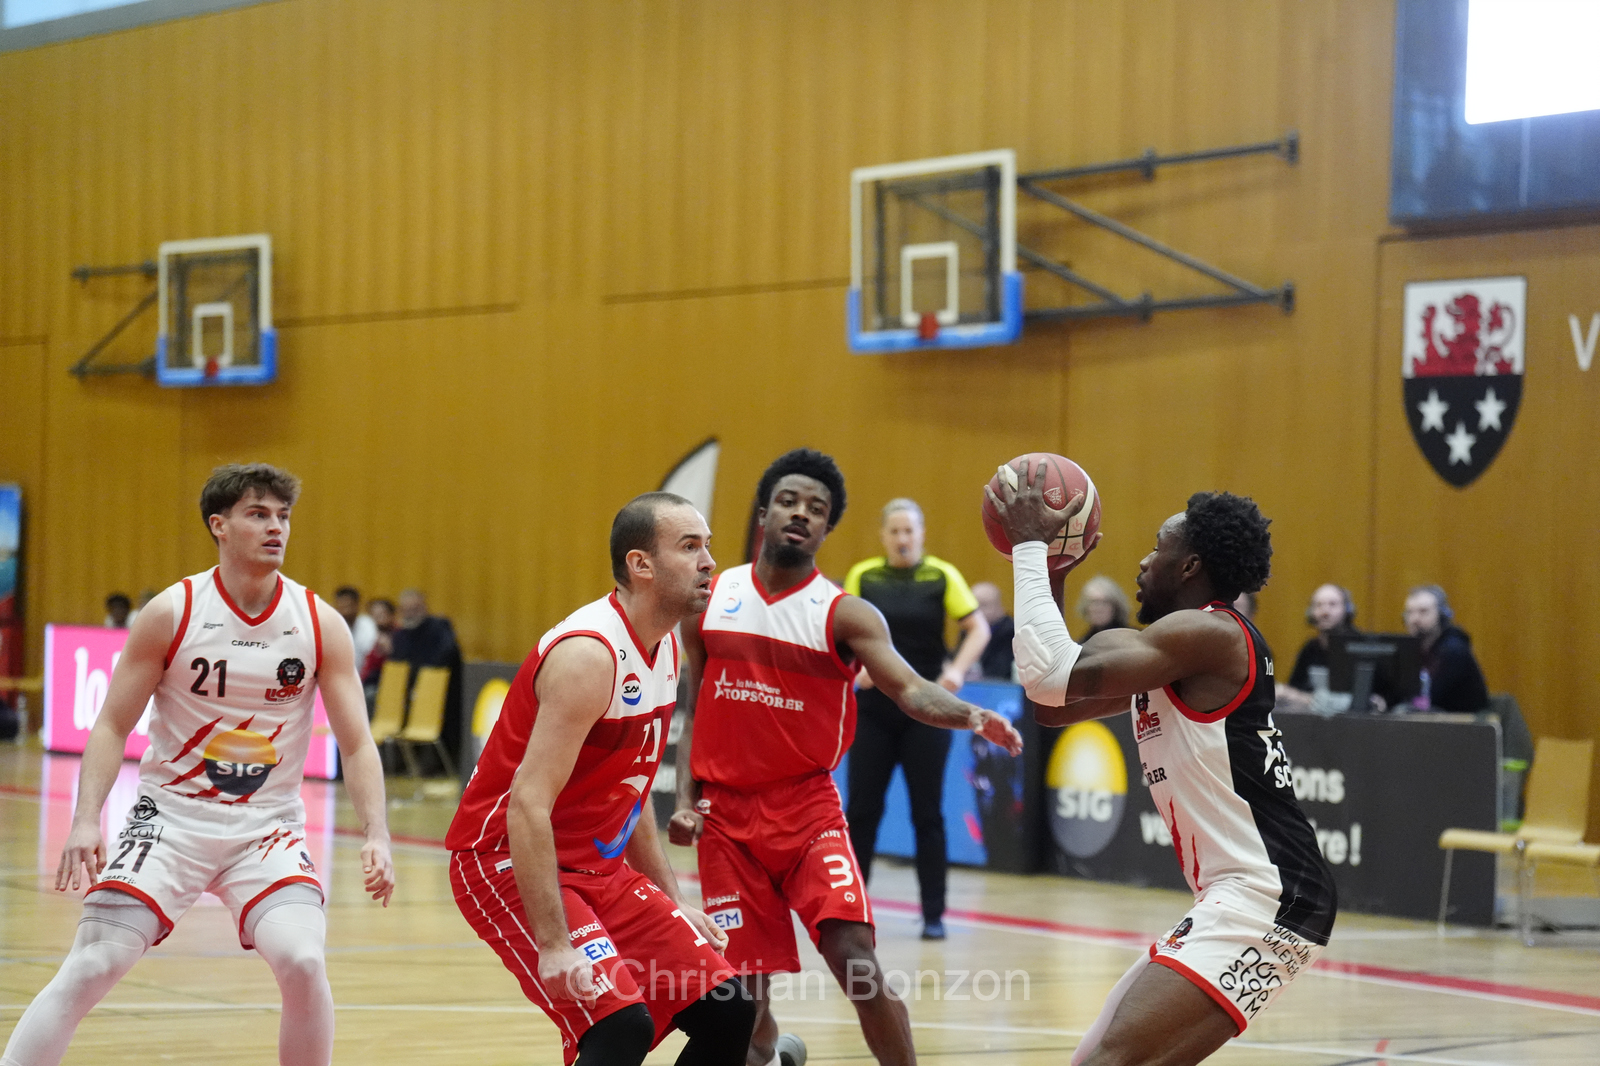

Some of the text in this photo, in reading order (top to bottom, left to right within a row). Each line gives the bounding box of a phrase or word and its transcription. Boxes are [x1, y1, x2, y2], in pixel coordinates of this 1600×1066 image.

[231, 640, 261, 648] CRAFT
[190, 657, 227, 698] 21
[724, 688, 804, 712] TOPSCORER
[216, 761, 266, 778] SIG
[1146, 767, 1167, 785] RER
[1056, 788, 1114, 823] SIG
[107, 839, 153, 874] 21
[822, 854, 854, 889] 3
[584, 940, 614, 963] EM
[1219, 971, 1262, 1021] GYM
